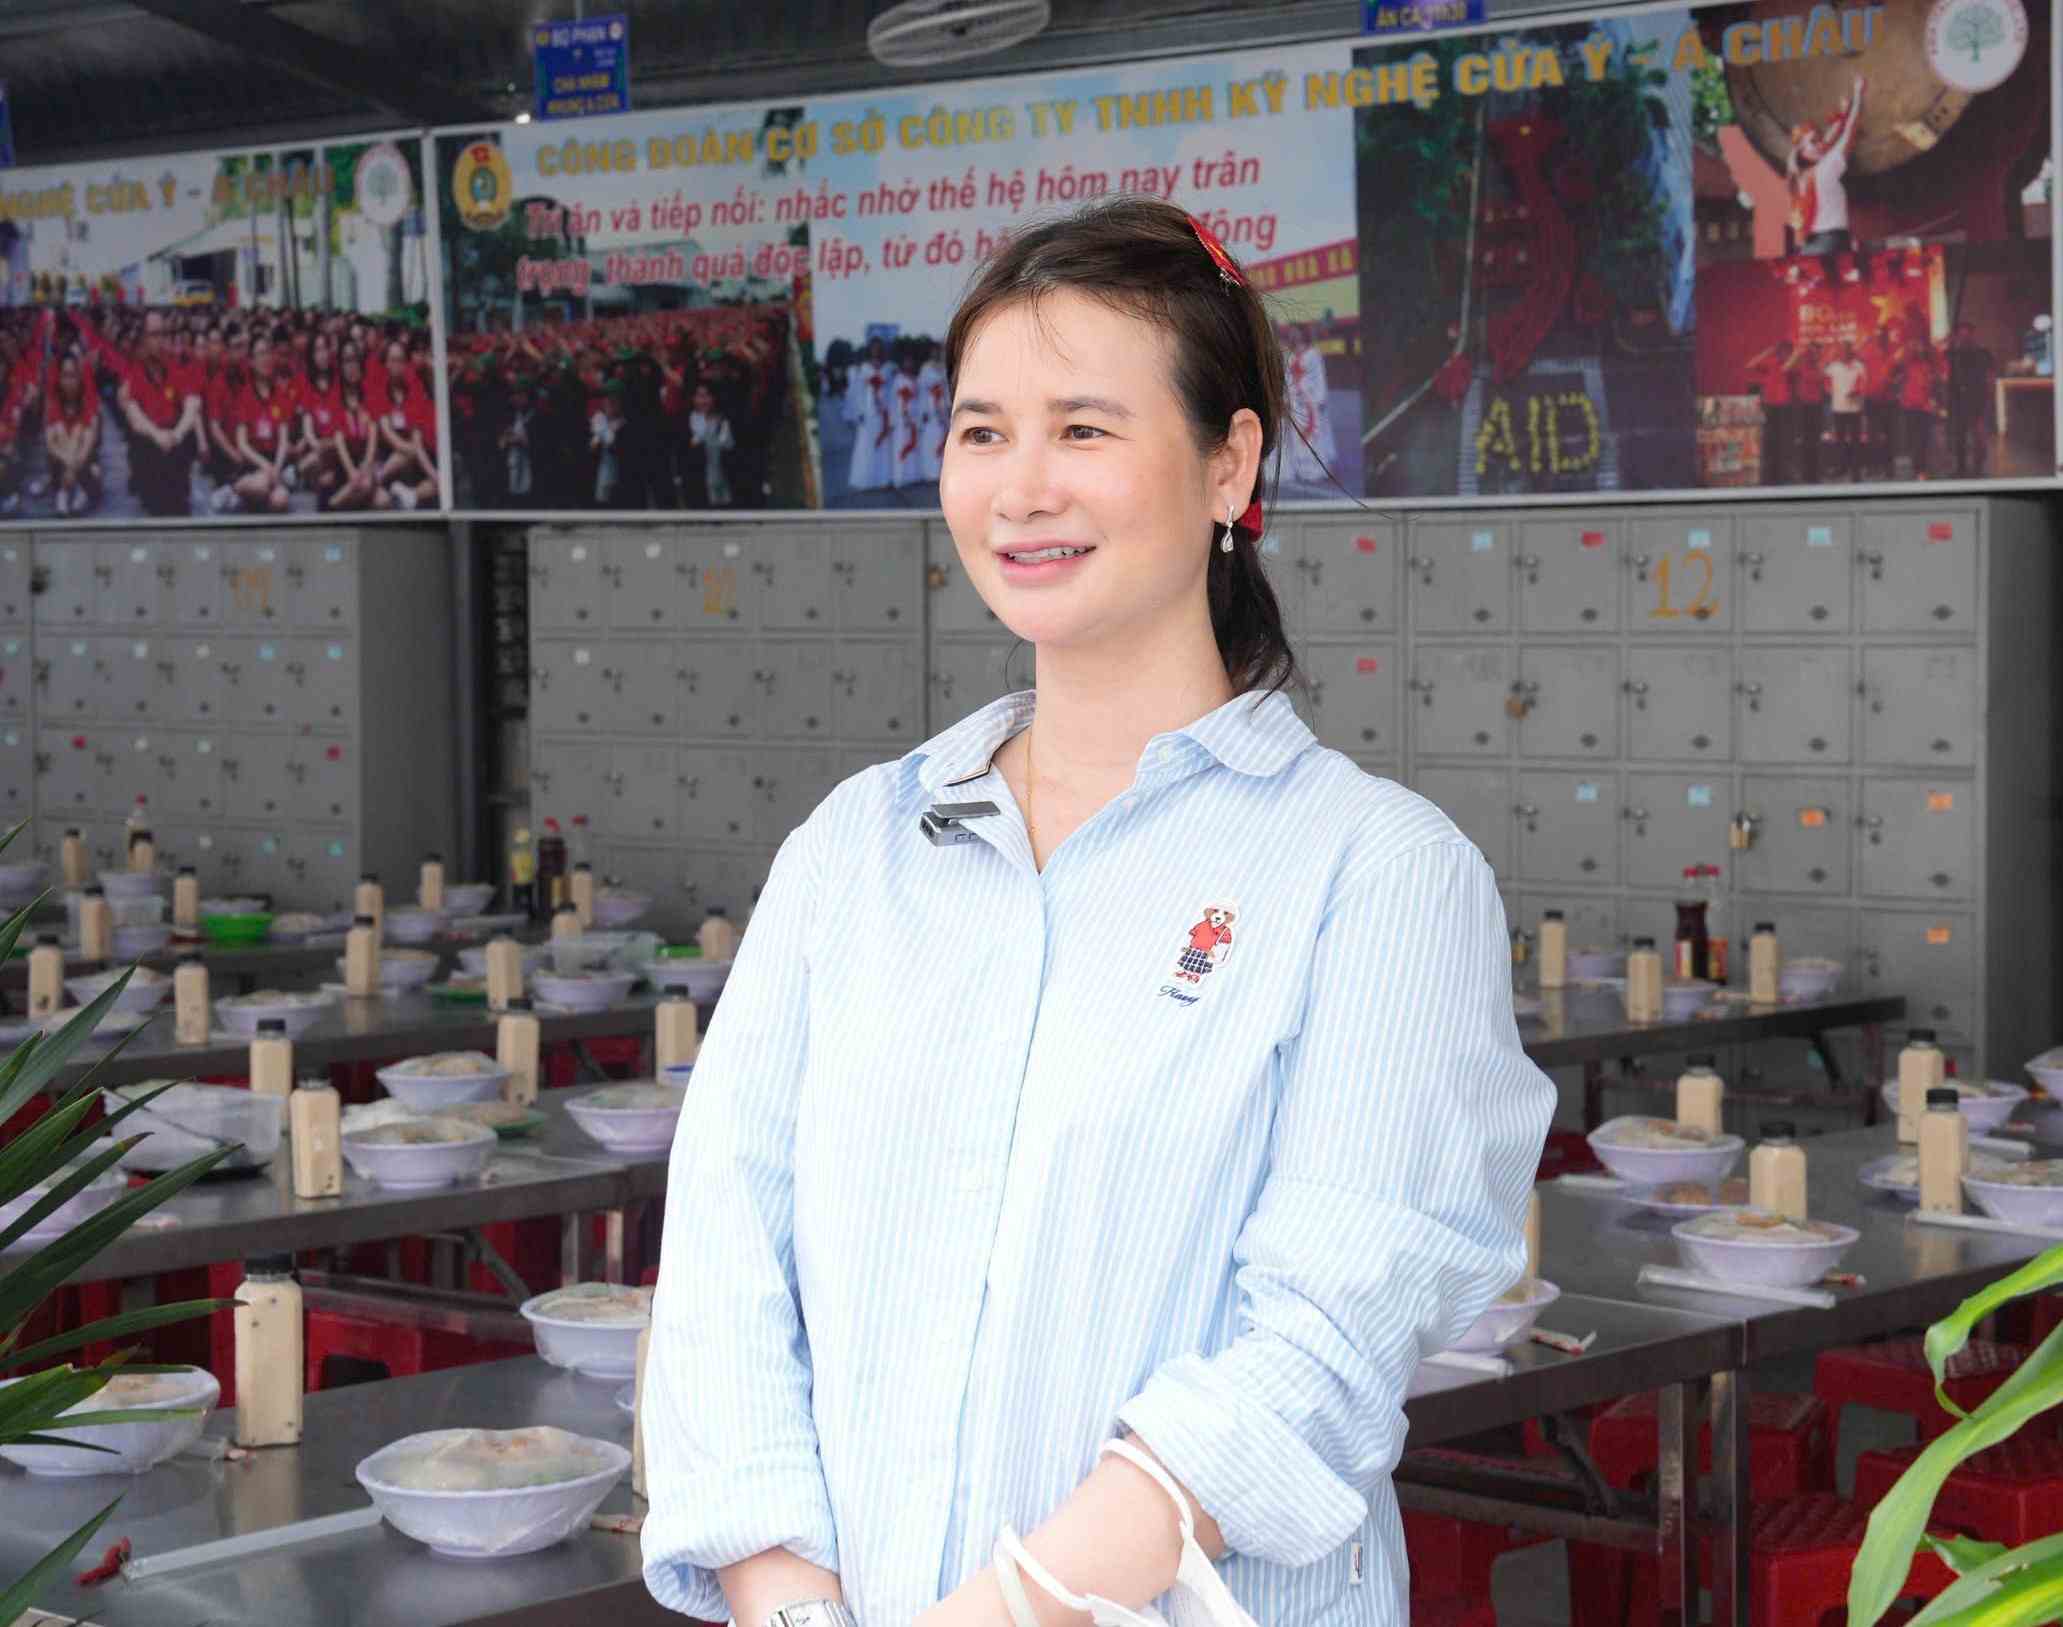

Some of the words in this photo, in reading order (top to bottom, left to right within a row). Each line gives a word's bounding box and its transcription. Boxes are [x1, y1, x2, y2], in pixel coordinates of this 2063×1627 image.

[537, 134, 637, 176] CÔNG
[648, 127, 753, 170] ĐOÀN
[767, 120, 818, 162] CƠ
[831, 106, 887, 156] SỞ
[900, 105, 1015, 150] CÔNG
[1028, 97, 1079, 139] TY
[1095, 84, 1214, 133] TNHH
[1303, 52, 1440, 111] NGHỆ
[1456, 38, 1564, 95] CỬA
[610, 204, 641, 233] và
[651, 188, 701, 233] tiếp
[711, 184, 766, 226] nối:
[775, 177, 848, 221] nhắc
[857, 177, 921, 217] nhở
[928, 165, 977, 211] thế
[986, 168, 1026, 213] hệ
[1036, 164, 1108, 204] hôm
[1119, 162, 1181, 201] nay
[1192, 149, 1261, 190] trân
[606, 246, 684, 284] thành
[692, 245, 745, 289] quả
[818, 234, 870, 280] lập,
[882, 233, 917, 269] từ
[925, 230, 965, 266] đó
[1475, 391, 1600, 474] AID
[1648, 548, 1721, 620] 12
